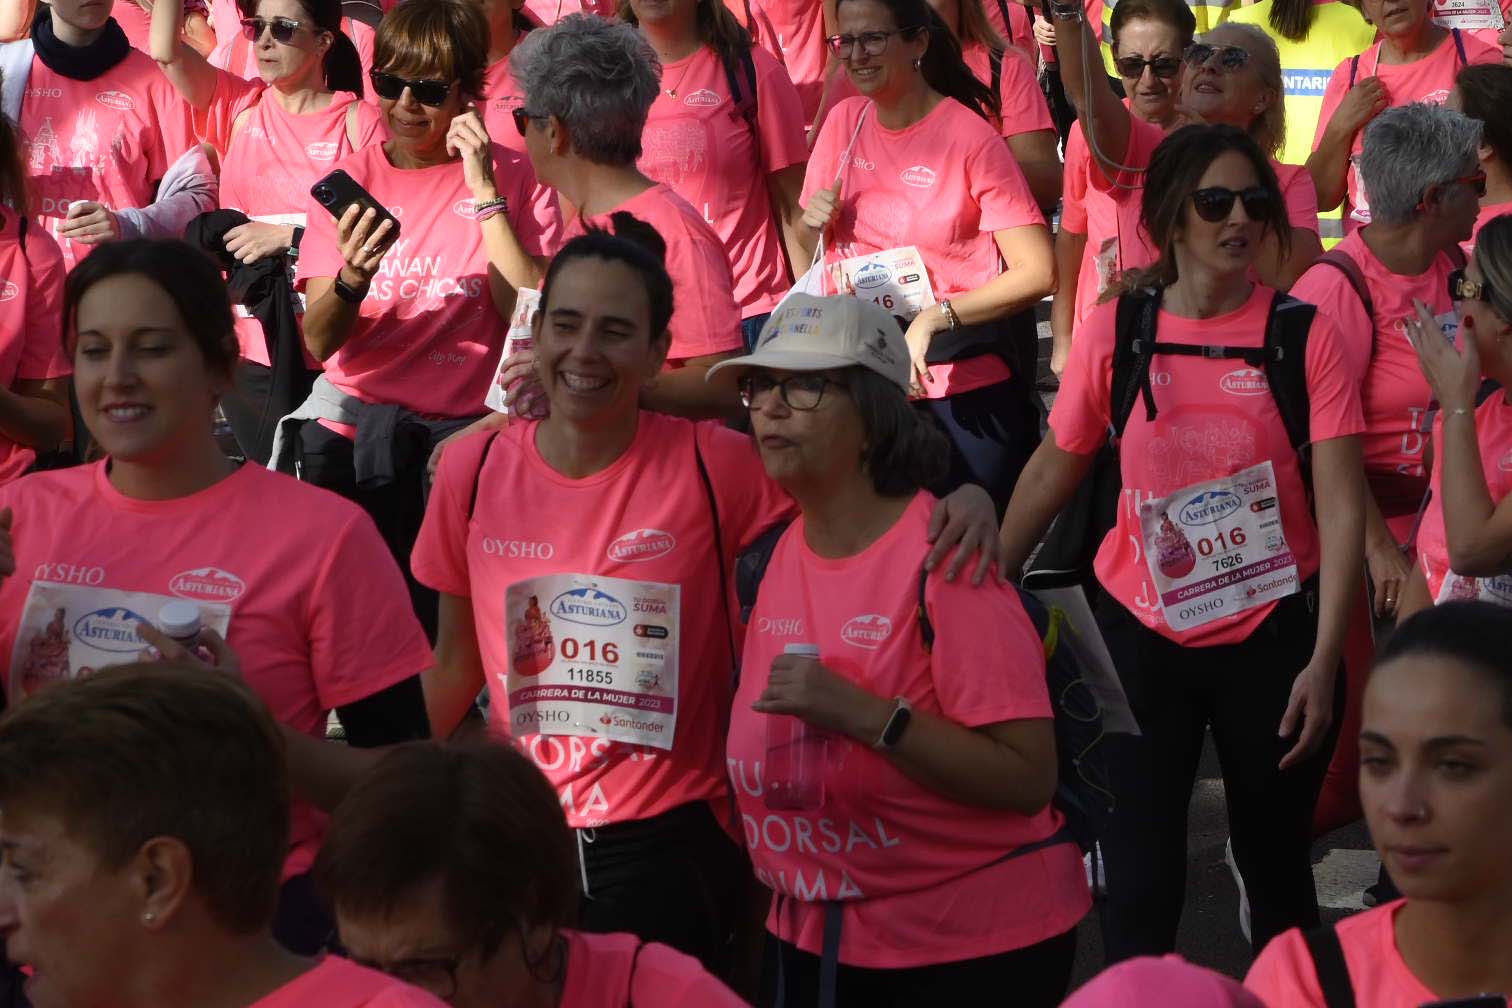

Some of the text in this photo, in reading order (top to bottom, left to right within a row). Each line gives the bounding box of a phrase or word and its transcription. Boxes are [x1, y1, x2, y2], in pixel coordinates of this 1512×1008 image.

[379, 255, 441, 278] ANAN
[399, 278, 482, 300] CHICAS
[1185, 499, 1238, 523] ASTURIANA
[482, 536, 555, 561] OYSHO
[611, 536, 674, 560] ASTURIANA
[1197, 526, 1247, 557] 016
[1212, 552, 1244, 572] 7626
[175, 574, 242, 598] ASTURIANA
[1177, 581, 1218, 600] CARRERA
[1218, 576, 1230, 586] DE
[1231, 572, 1242, 581] LA
[1242, 562, 1272, 579] MUJER
[556, 600, 622, 621] ASTURIANA
[633, 602, 667, 615] SUMA
[1179, 597, 1225, 620] OYSHO
[560, 637, 620, 664] 016
[567, 668, 613, 685] 11855
[521, 686, 569, 701] CARRERA
[571, 689, 585, 699] DE
[587, 690, 600, 701] LA
[602, 693, 636, 705] MUJER
[516, 709, 570, 727] OYSHO
[613, 715, 665, 733] Santander
[743, 814, 900, 854] DORSAL
